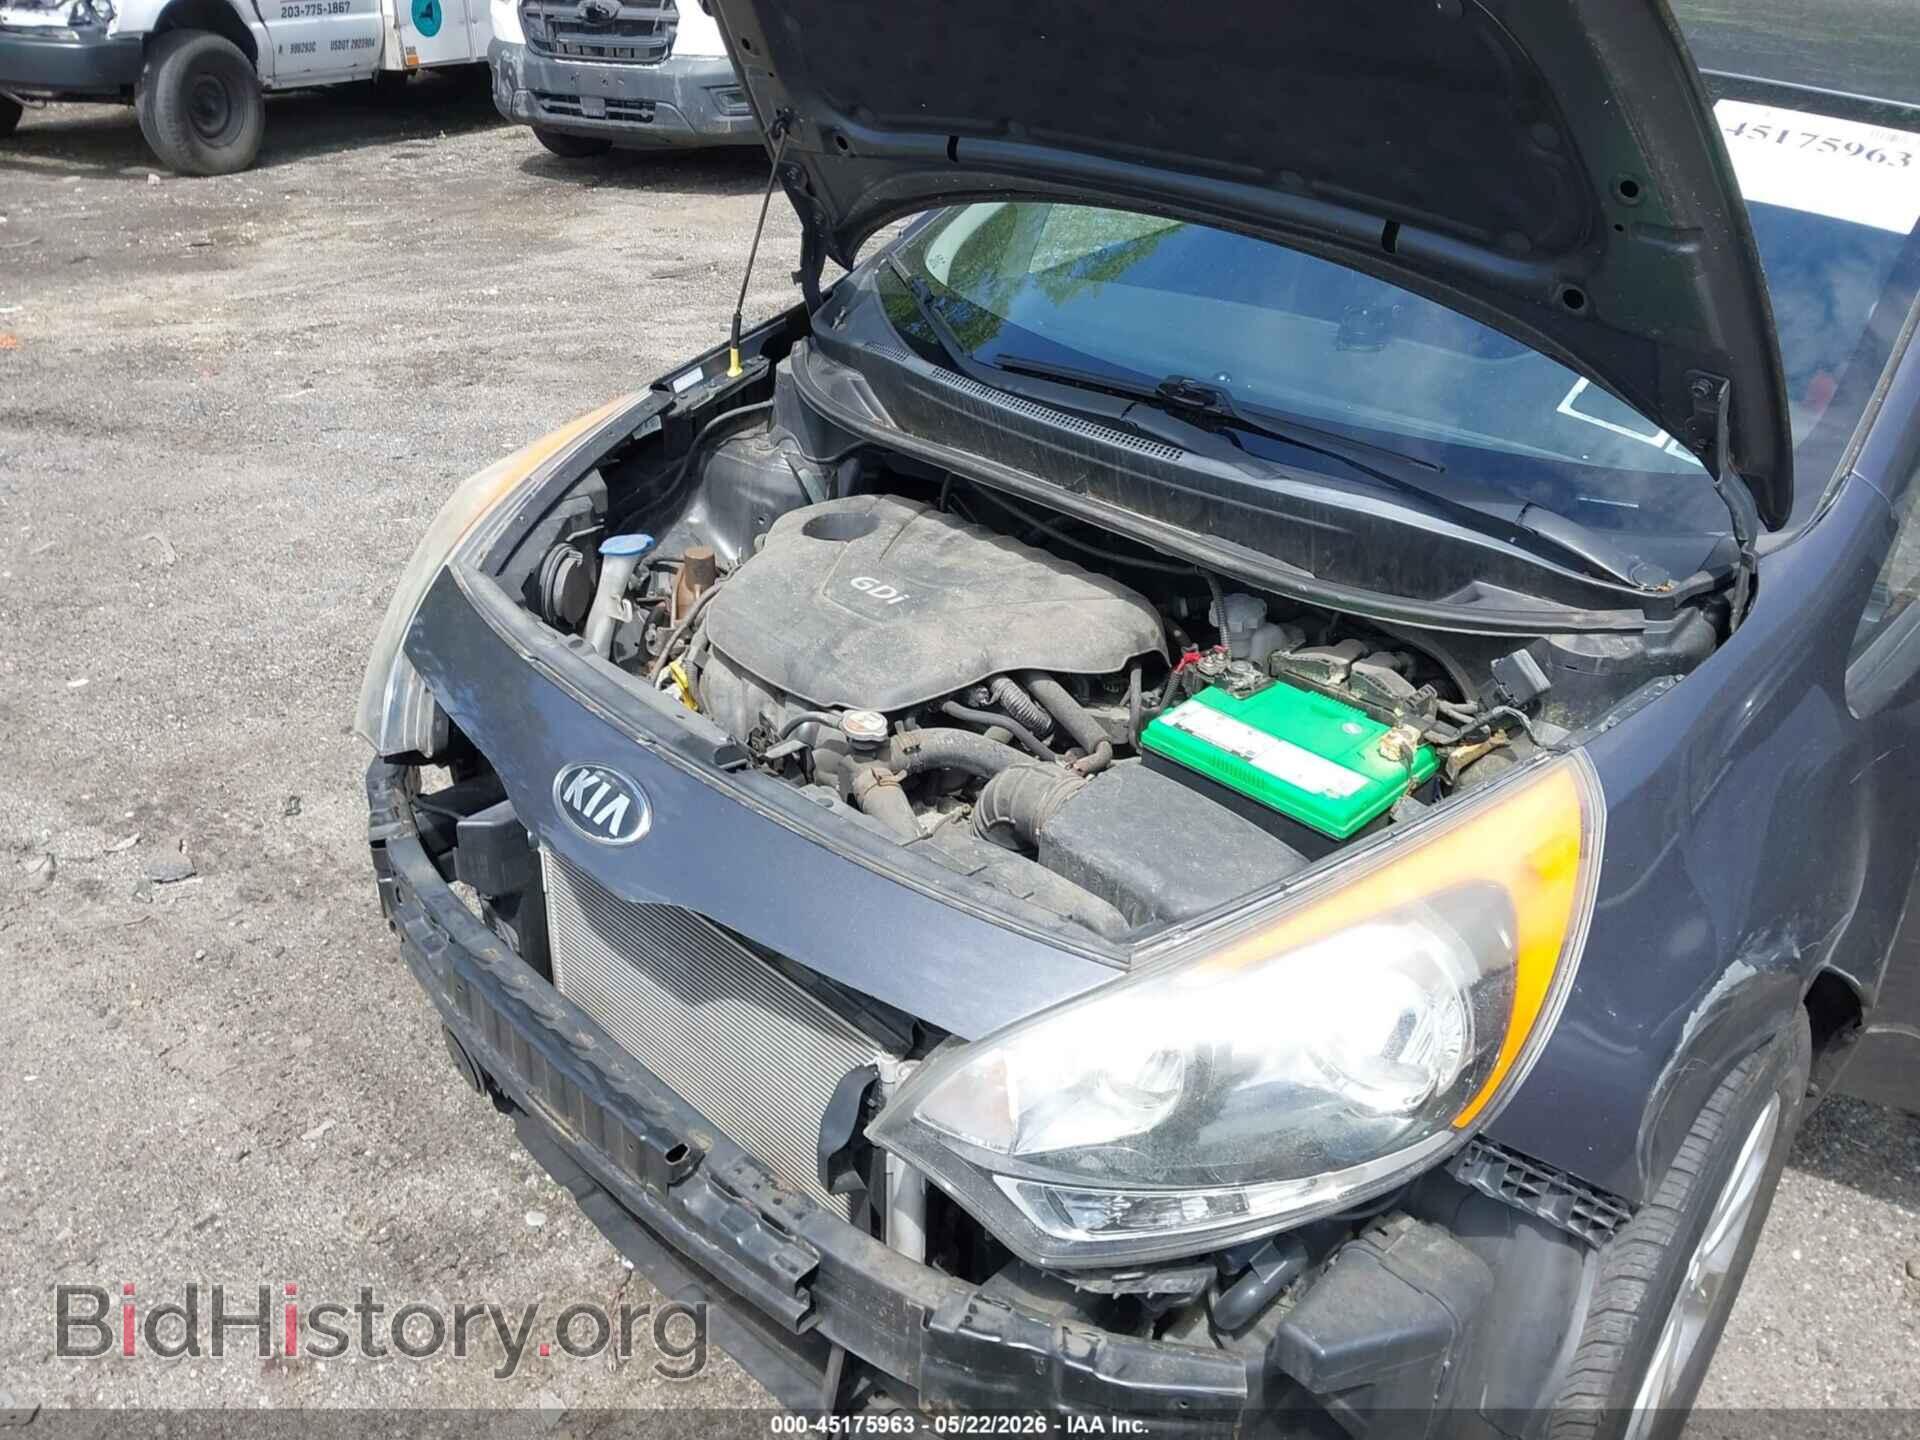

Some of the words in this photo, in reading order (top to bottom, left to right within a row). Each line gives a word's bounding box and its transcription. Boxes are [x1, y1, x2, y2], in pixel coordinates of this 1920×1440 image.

[281, 1, 350, 18] 203-775-1867
[1725, 121, 1912, 167] 45175963
[850, 576, 910, 604] GDi
[563, 768, 630, 836] KIA
